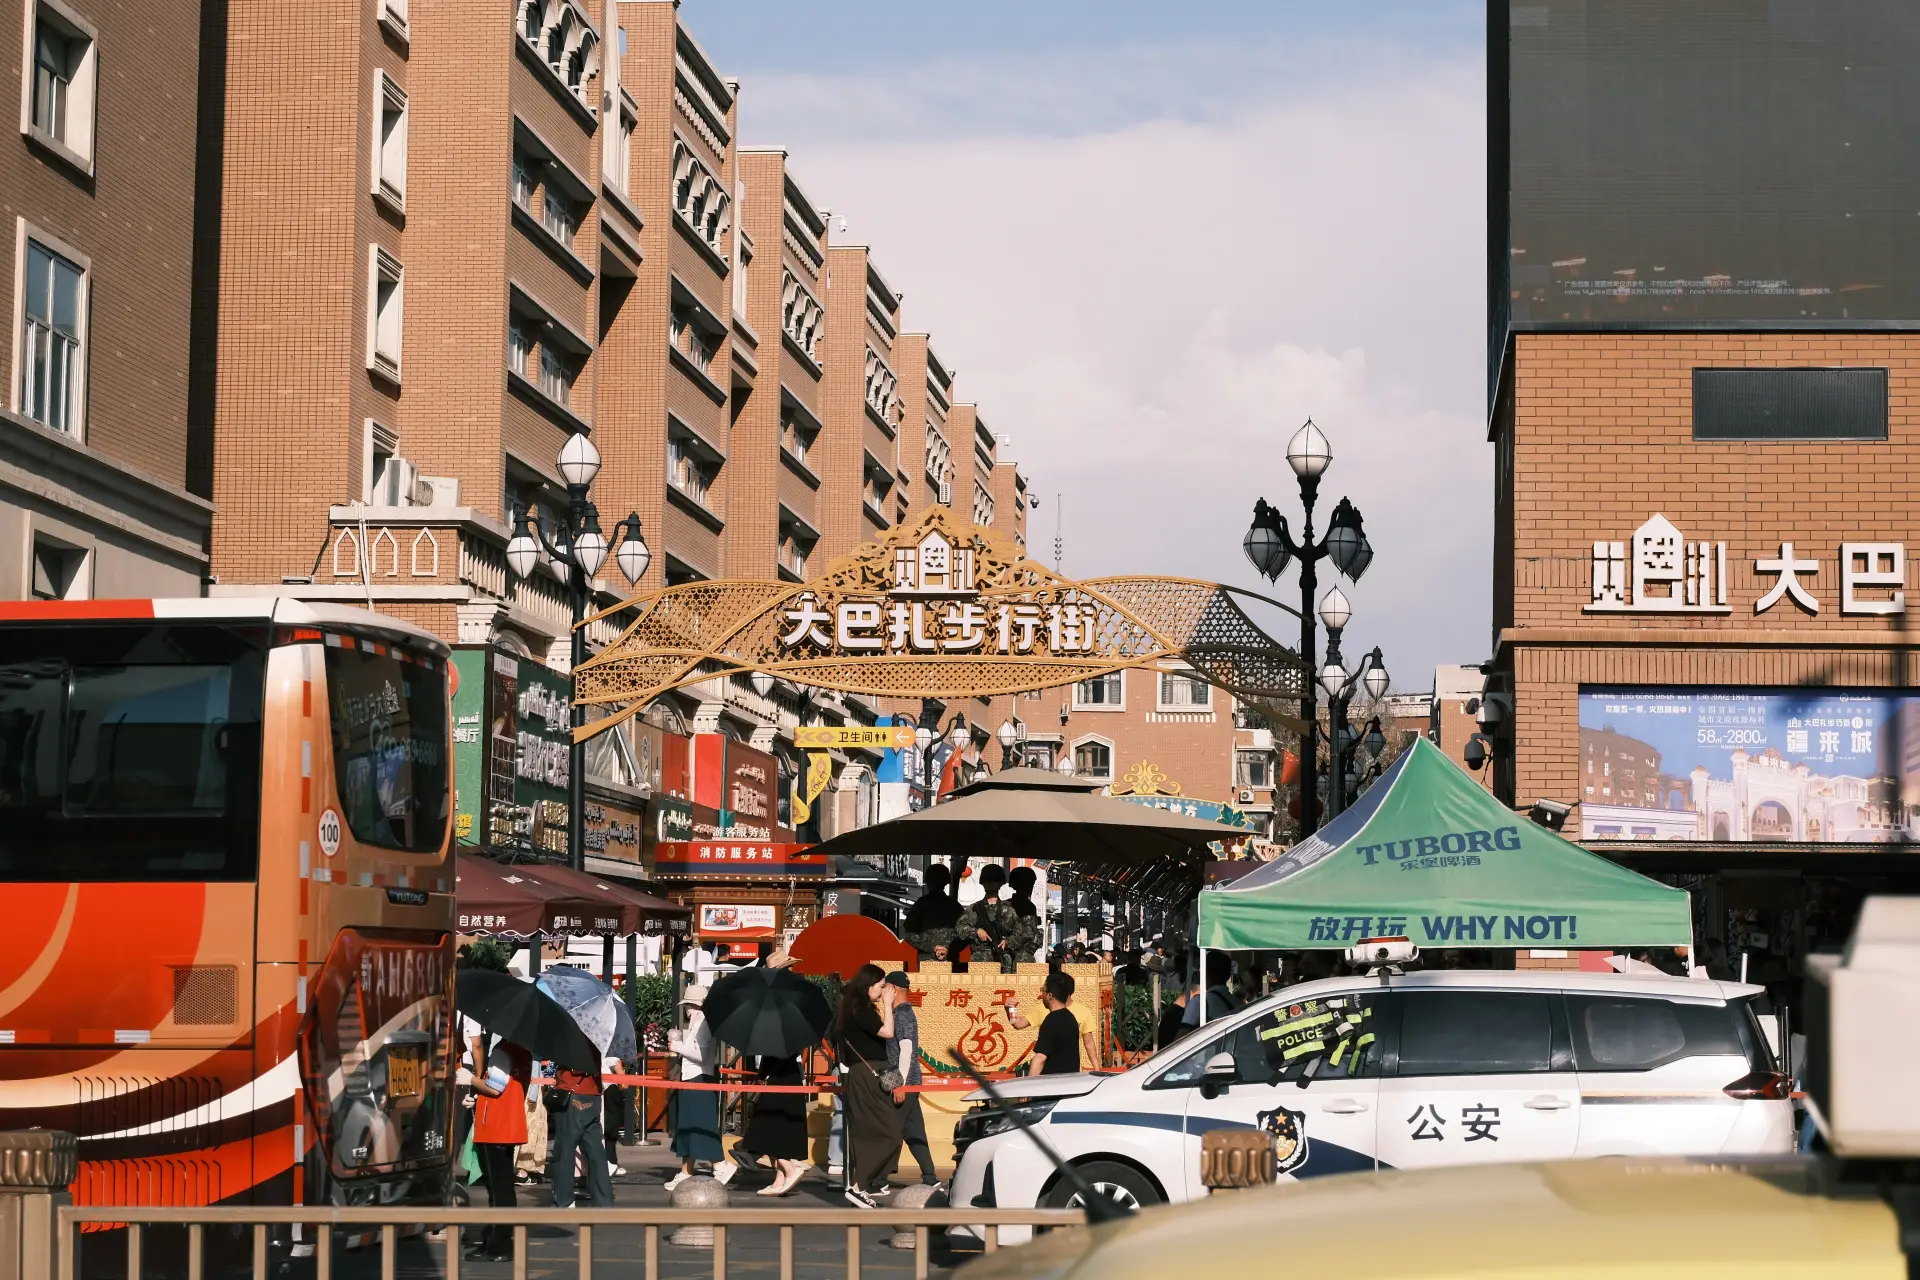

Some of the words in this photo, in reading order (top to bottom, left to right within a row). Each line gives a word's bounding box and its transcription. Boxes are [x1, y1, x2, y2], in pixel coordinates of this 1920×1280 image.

[1755, 541, 1906, 616] 大巴
[782, 595, 1097, 652] 大巴扎步行街
[838, 731, 873, 743] 卫生间
[811, 771, 827, 794] TOILET
[321, 823, 339, 843] 100
[712, 826, 771, 839] 游客服务站
[699, 846, 773, 860] 消防服务站
[1356, 826, 1521, 866] TUBORG
[1400, 855, 1481, 872] 乐堡啤酒
[396, 893, 425, 903] YUTONG
[459, 915, 507, 927] 自然营养
[1308, 915, 1408, 941] 放开玩
[1422, 915, 1498, 941] WHY
[1504, 915, 1578, 941] NOT!
[1274, 1000, 1317, 1023] 警察
[1277, 1028, 1324, 1050] POLICE
[1407, 1103, 1501, 1142] 公安
